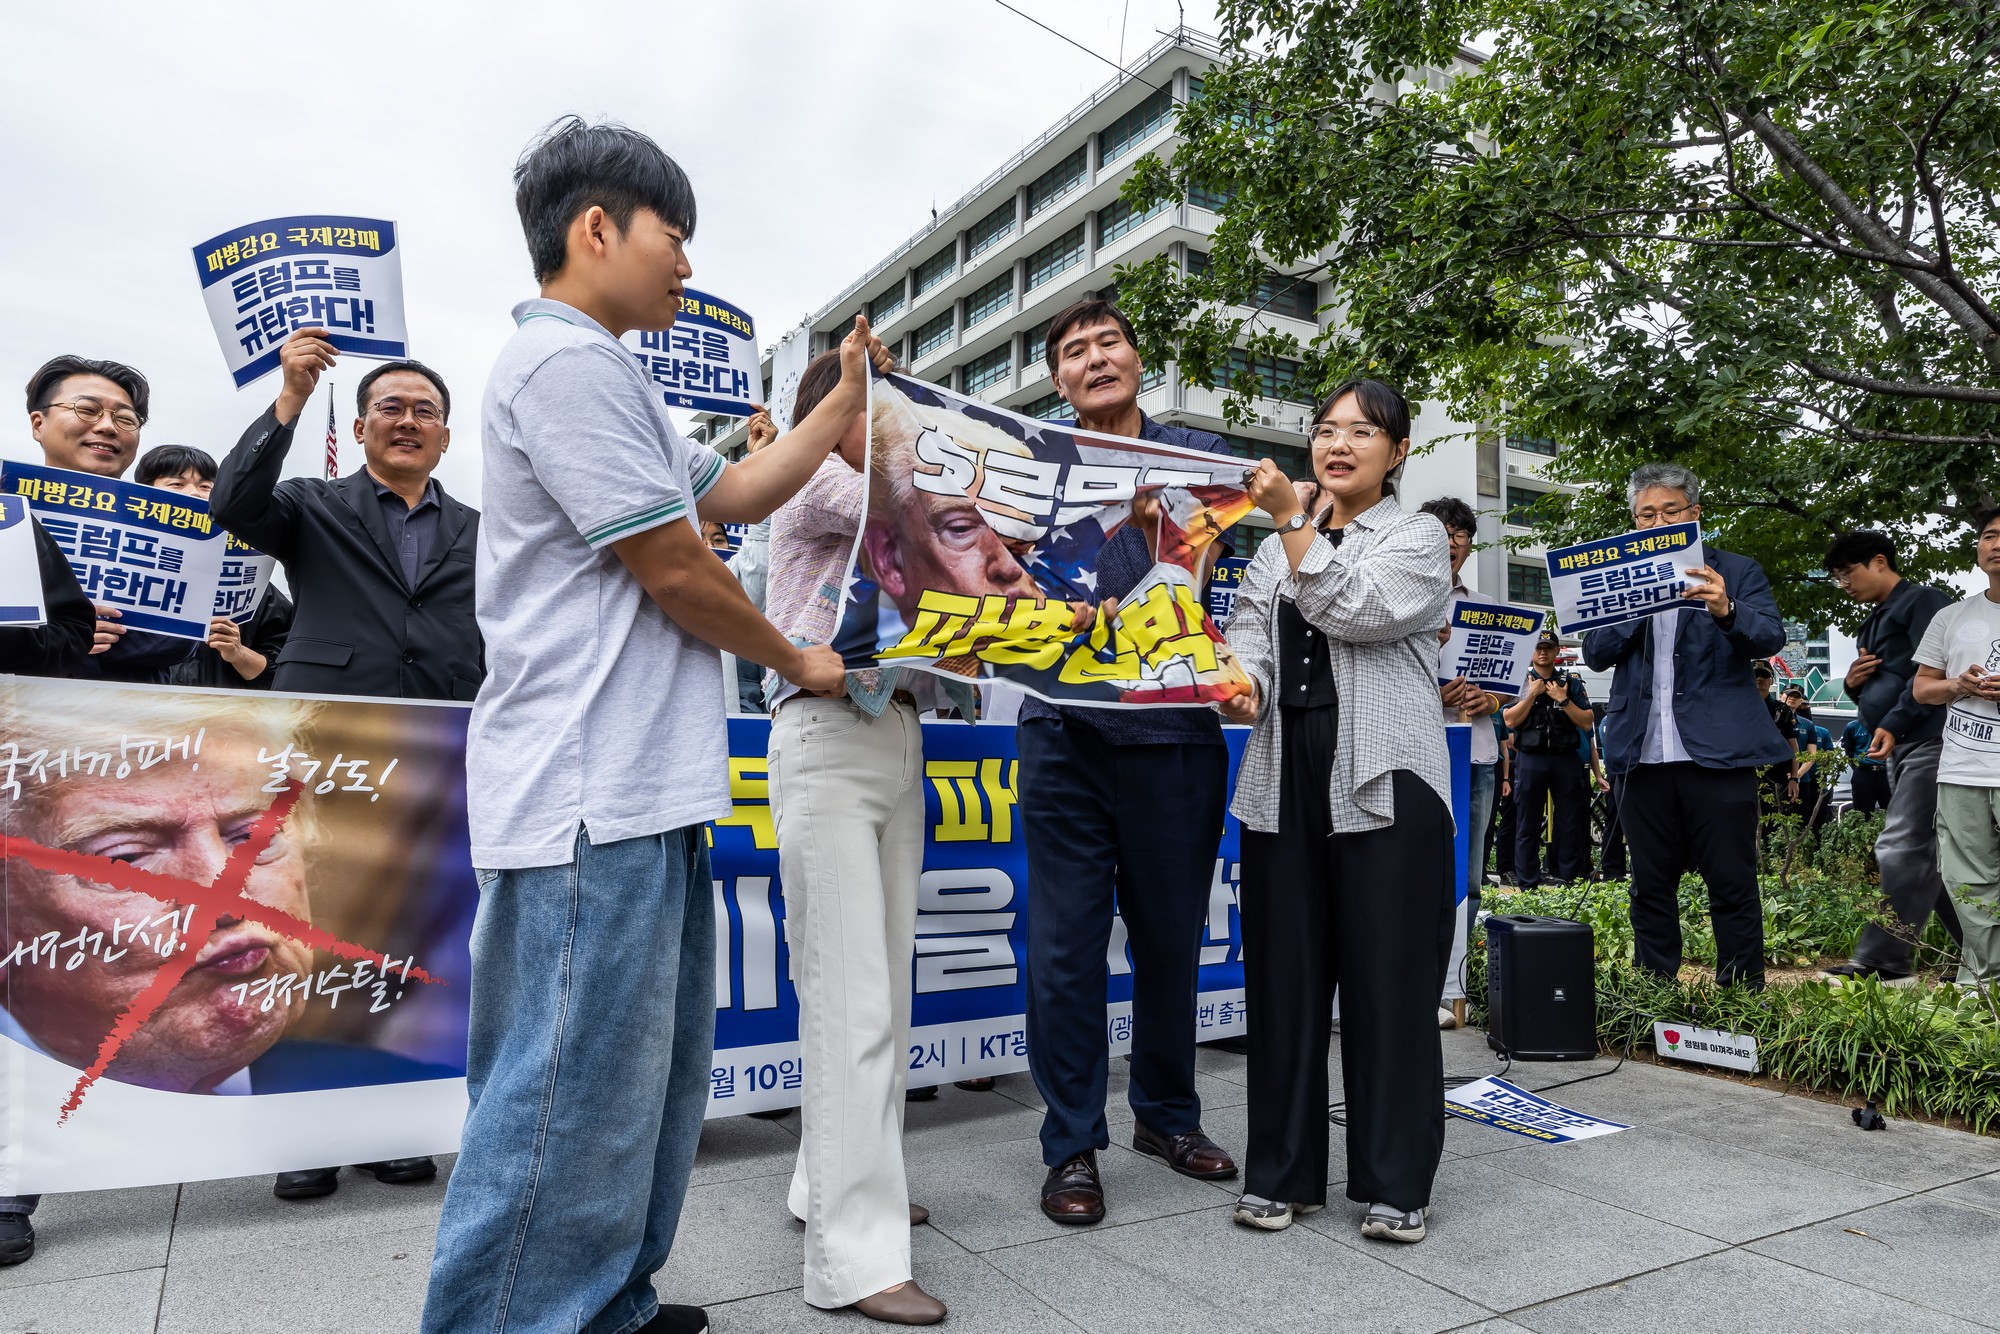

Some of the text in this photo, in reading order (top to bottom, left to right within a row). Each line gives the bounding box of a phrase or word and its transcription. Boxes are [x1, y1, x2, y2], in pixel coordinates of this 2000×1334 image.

[206, 226, 380, 272] 파병강요 국제깡패
[231, 259, 361, 315] 트럼프를
[235, 296, 375, 357] 규탄한다!
[705, 303, 752, 336] 파병강요
[640, 325, 729, 363] 미국을
[633, 353, 749, 399] 탄한다!
[16, 477, 117, 513] 파병강요
[124, 496, 213, 534] 국제깡패
[40, 517, 184, 574] 트럼프를
[1558, 531, 1687, 569] 파병강요 국제깡패
[74, 563, 187, 614] 탄한다!
[1580, 561, 1675, 597] 트럼프를
[1576, 580, 1685, 619] 규탄한다!
[1460, 610, 1535, 632] 파병강요 국제깡패
[1464, 633, 1515, 656] 트럼프를
[1456, 657, 1514, 680] 규탄한다!
[1968, 721, 1993, 740] STAR
[0, 727, 206, 801] 국제깡패!
[256, 742, 399, 802] 날강도!
[230, 954, 414, 1013] 경제수탈!
[744, 1057, 802, 1092] 10일
[1195, 1003, 1215, 1028] 번
[1684, 1039, 1750, 1059] 정원을 아껴주세요
[1471, 1099, 1562, 1130] 트럼프를
[1481, 1088, 1598, 1128] 규탄한다!
[1493, 1119, 1559, 1140] 파병강요
